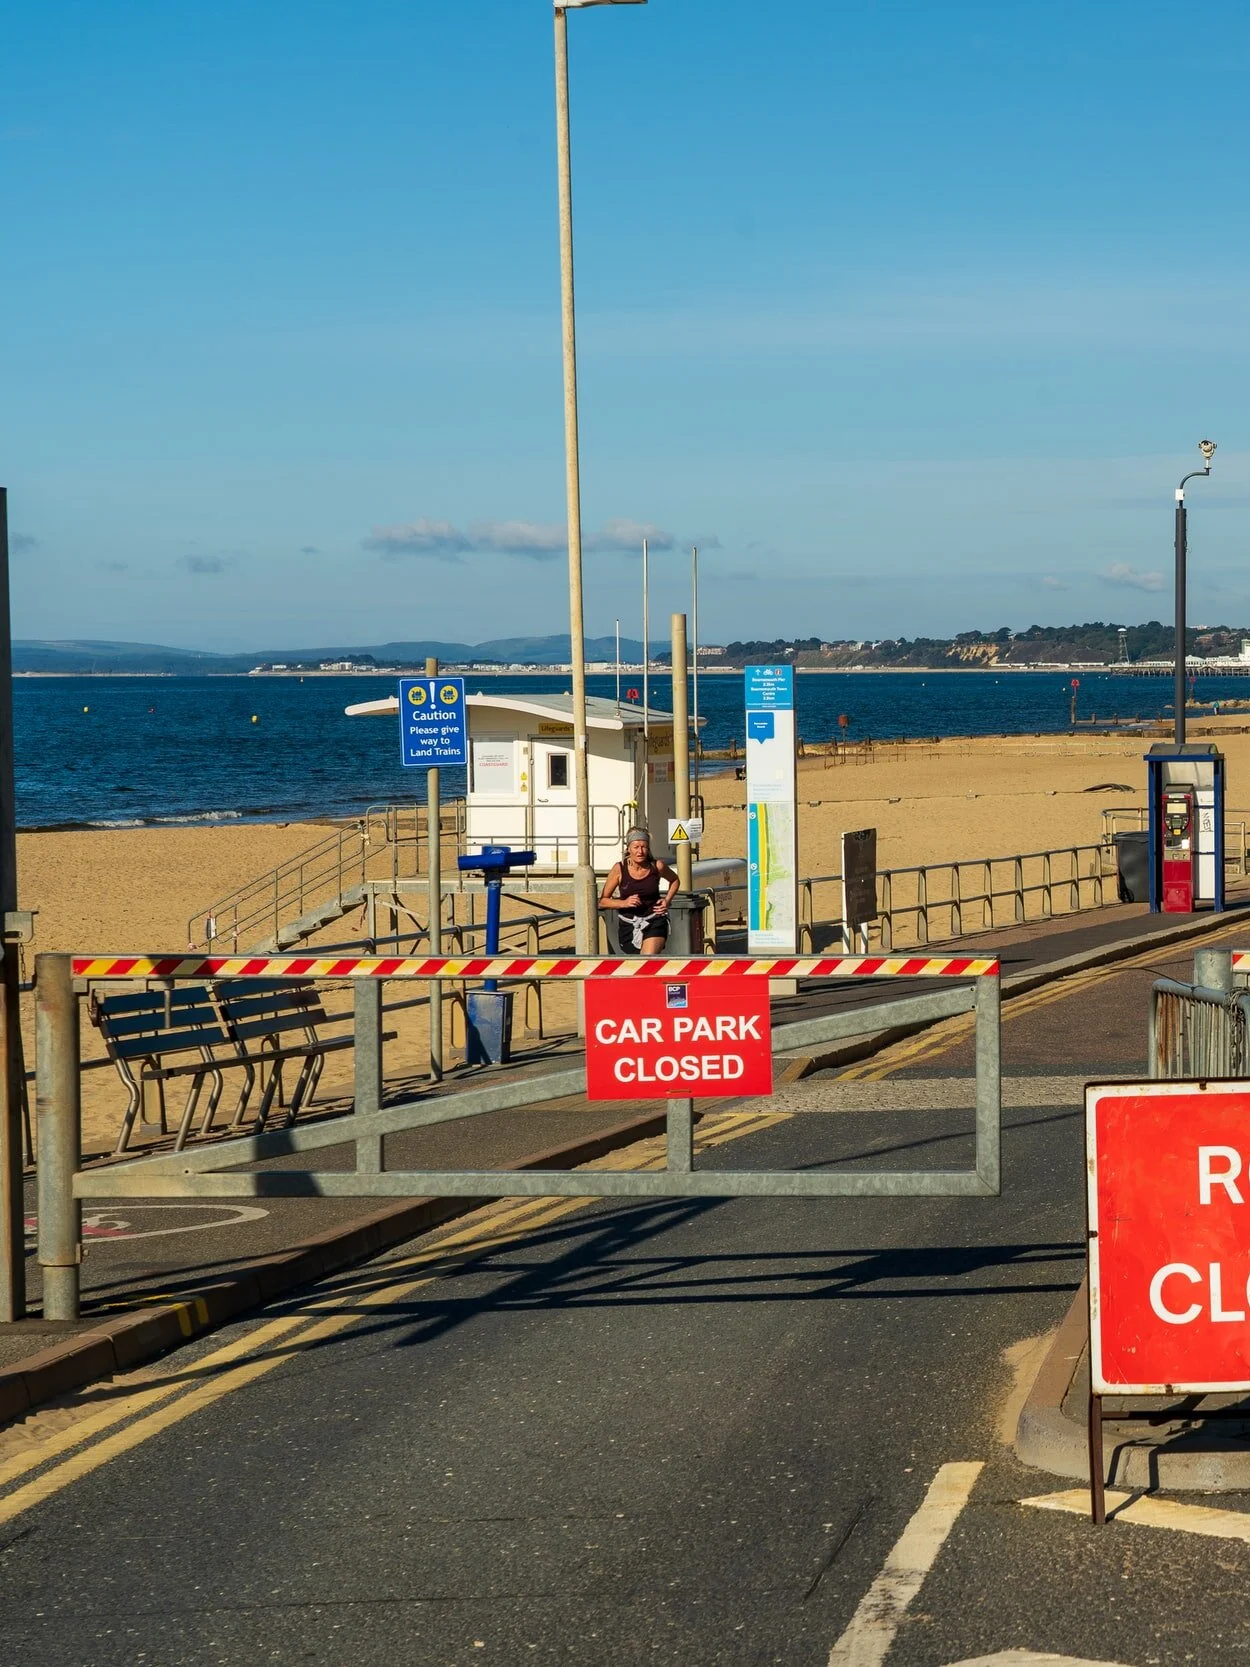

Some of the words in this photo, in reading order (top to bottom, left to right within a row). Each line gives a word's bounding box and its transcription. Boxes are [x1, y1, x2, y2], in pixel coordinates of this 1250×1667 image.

[412, 710, 456, 720] Caution
[410, 726, 438, 734] Please
[441, 726, 460, 736] give
[420, 738, 438, 746] way
[410, 748, 432, 756] Land
[434, 747, 461, 756] Trains
[595, 1018, 664, 1044] CAR
[673, 1015, 761, 1042] PARK
[614, 1054, 744, 1083] CLOSED
